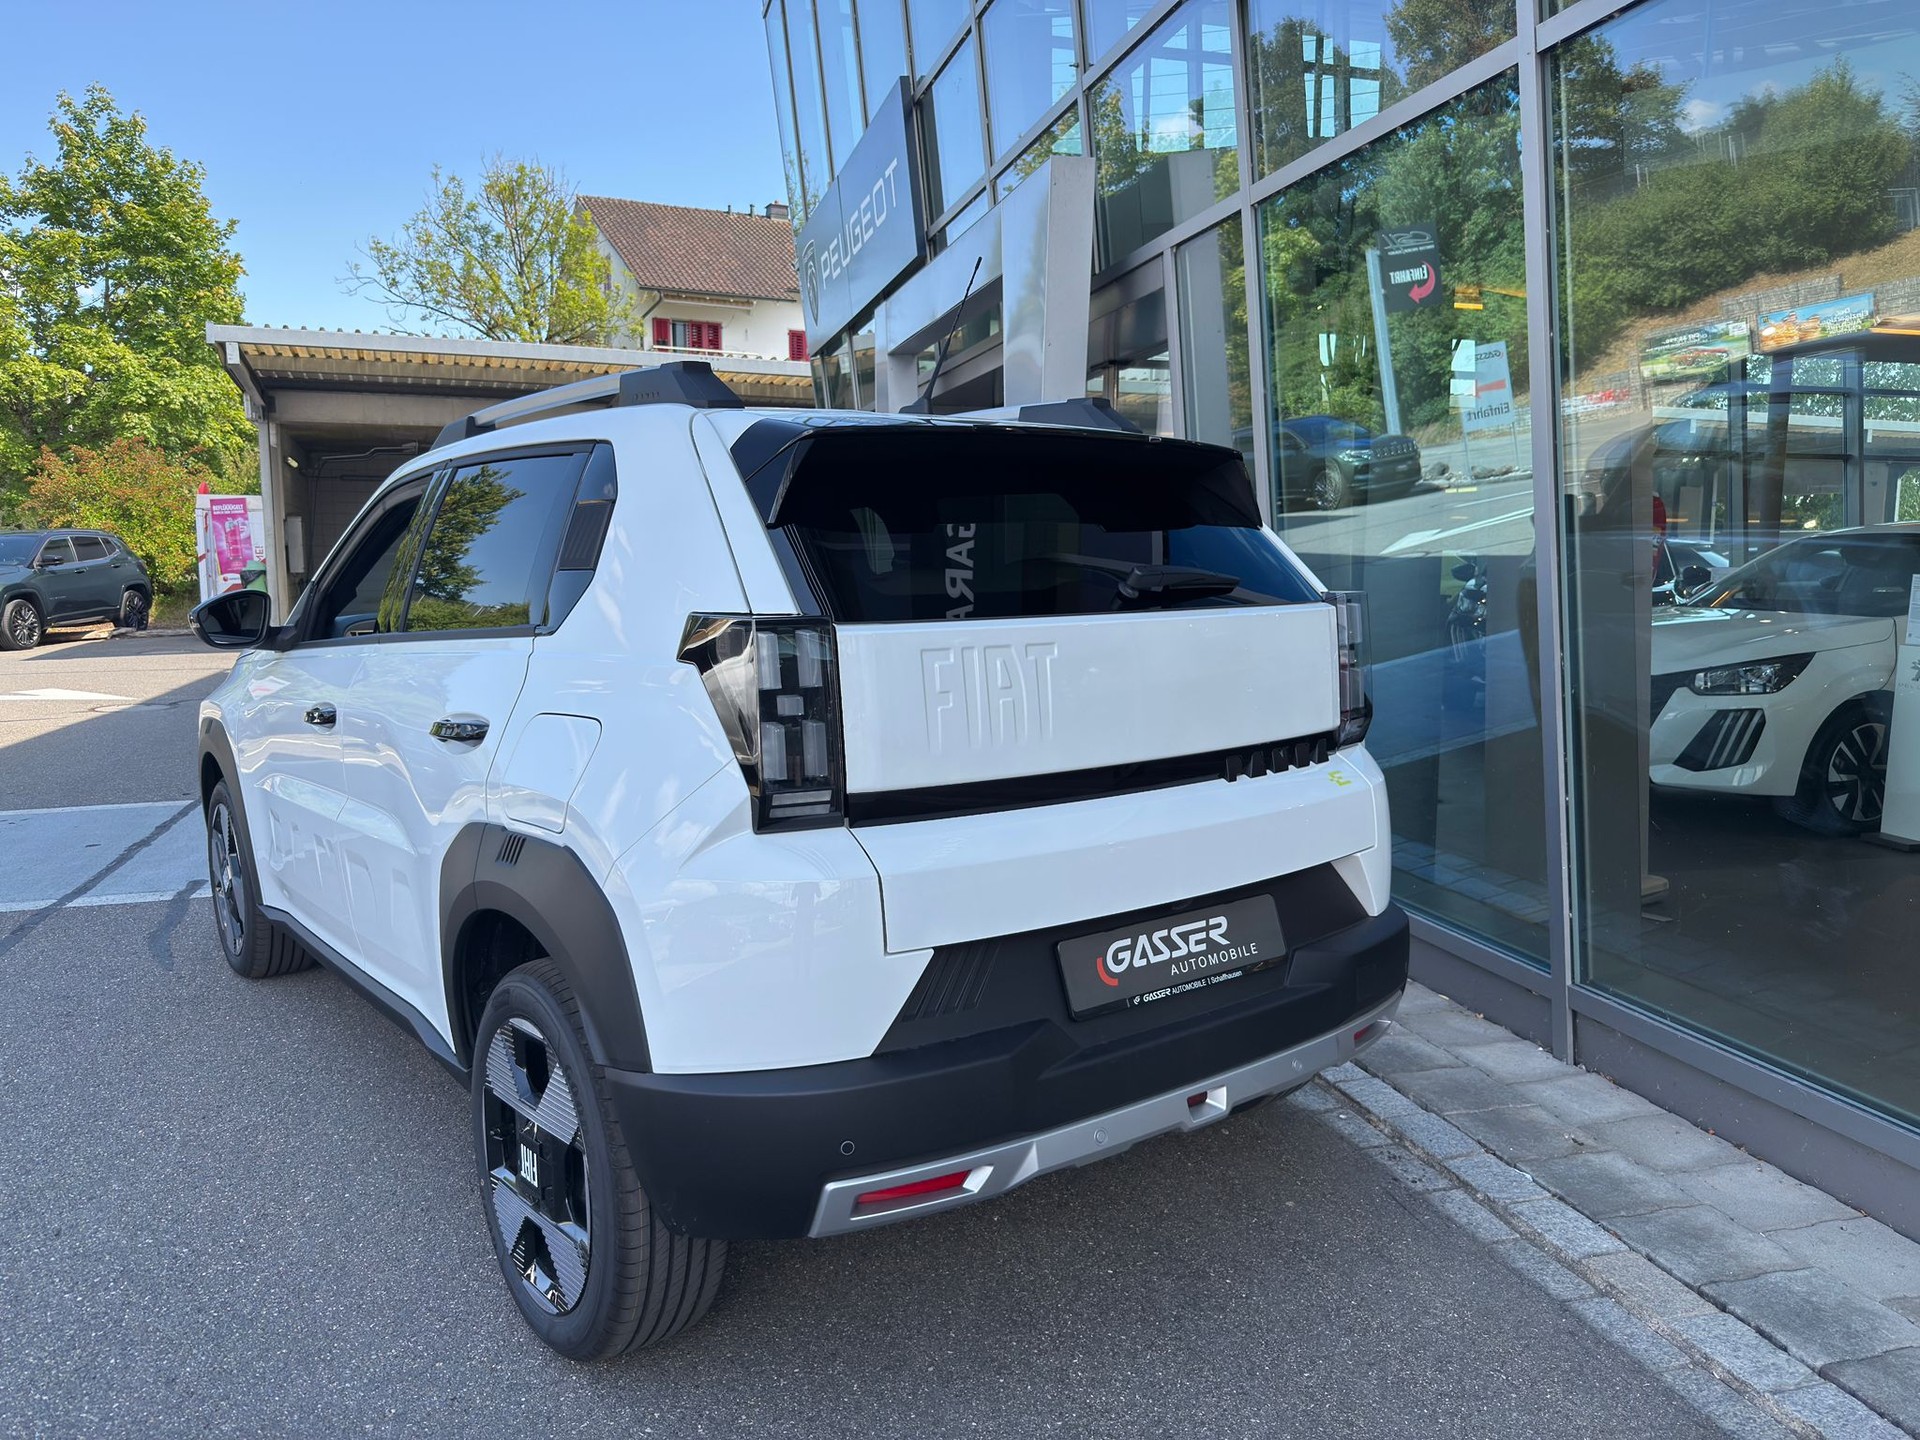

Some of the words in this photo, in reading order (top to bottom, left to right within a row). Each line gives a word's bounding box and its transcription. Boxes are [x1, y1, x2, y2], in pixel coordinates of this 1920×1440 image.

[821, 157, 898, 290] PEUGEOT
[920, 641, 1058, 752] FIAT
[1106, 915, 1231, 974] GASSER
[1170, 942, 1259, 976] AUTOMOBILE
[1143, 987, 1171, 1002] GASSER
[1171, 978, 1207, 995] AUTOMOBILE
[1211, 970, 1243, 984] Schaffhausen
